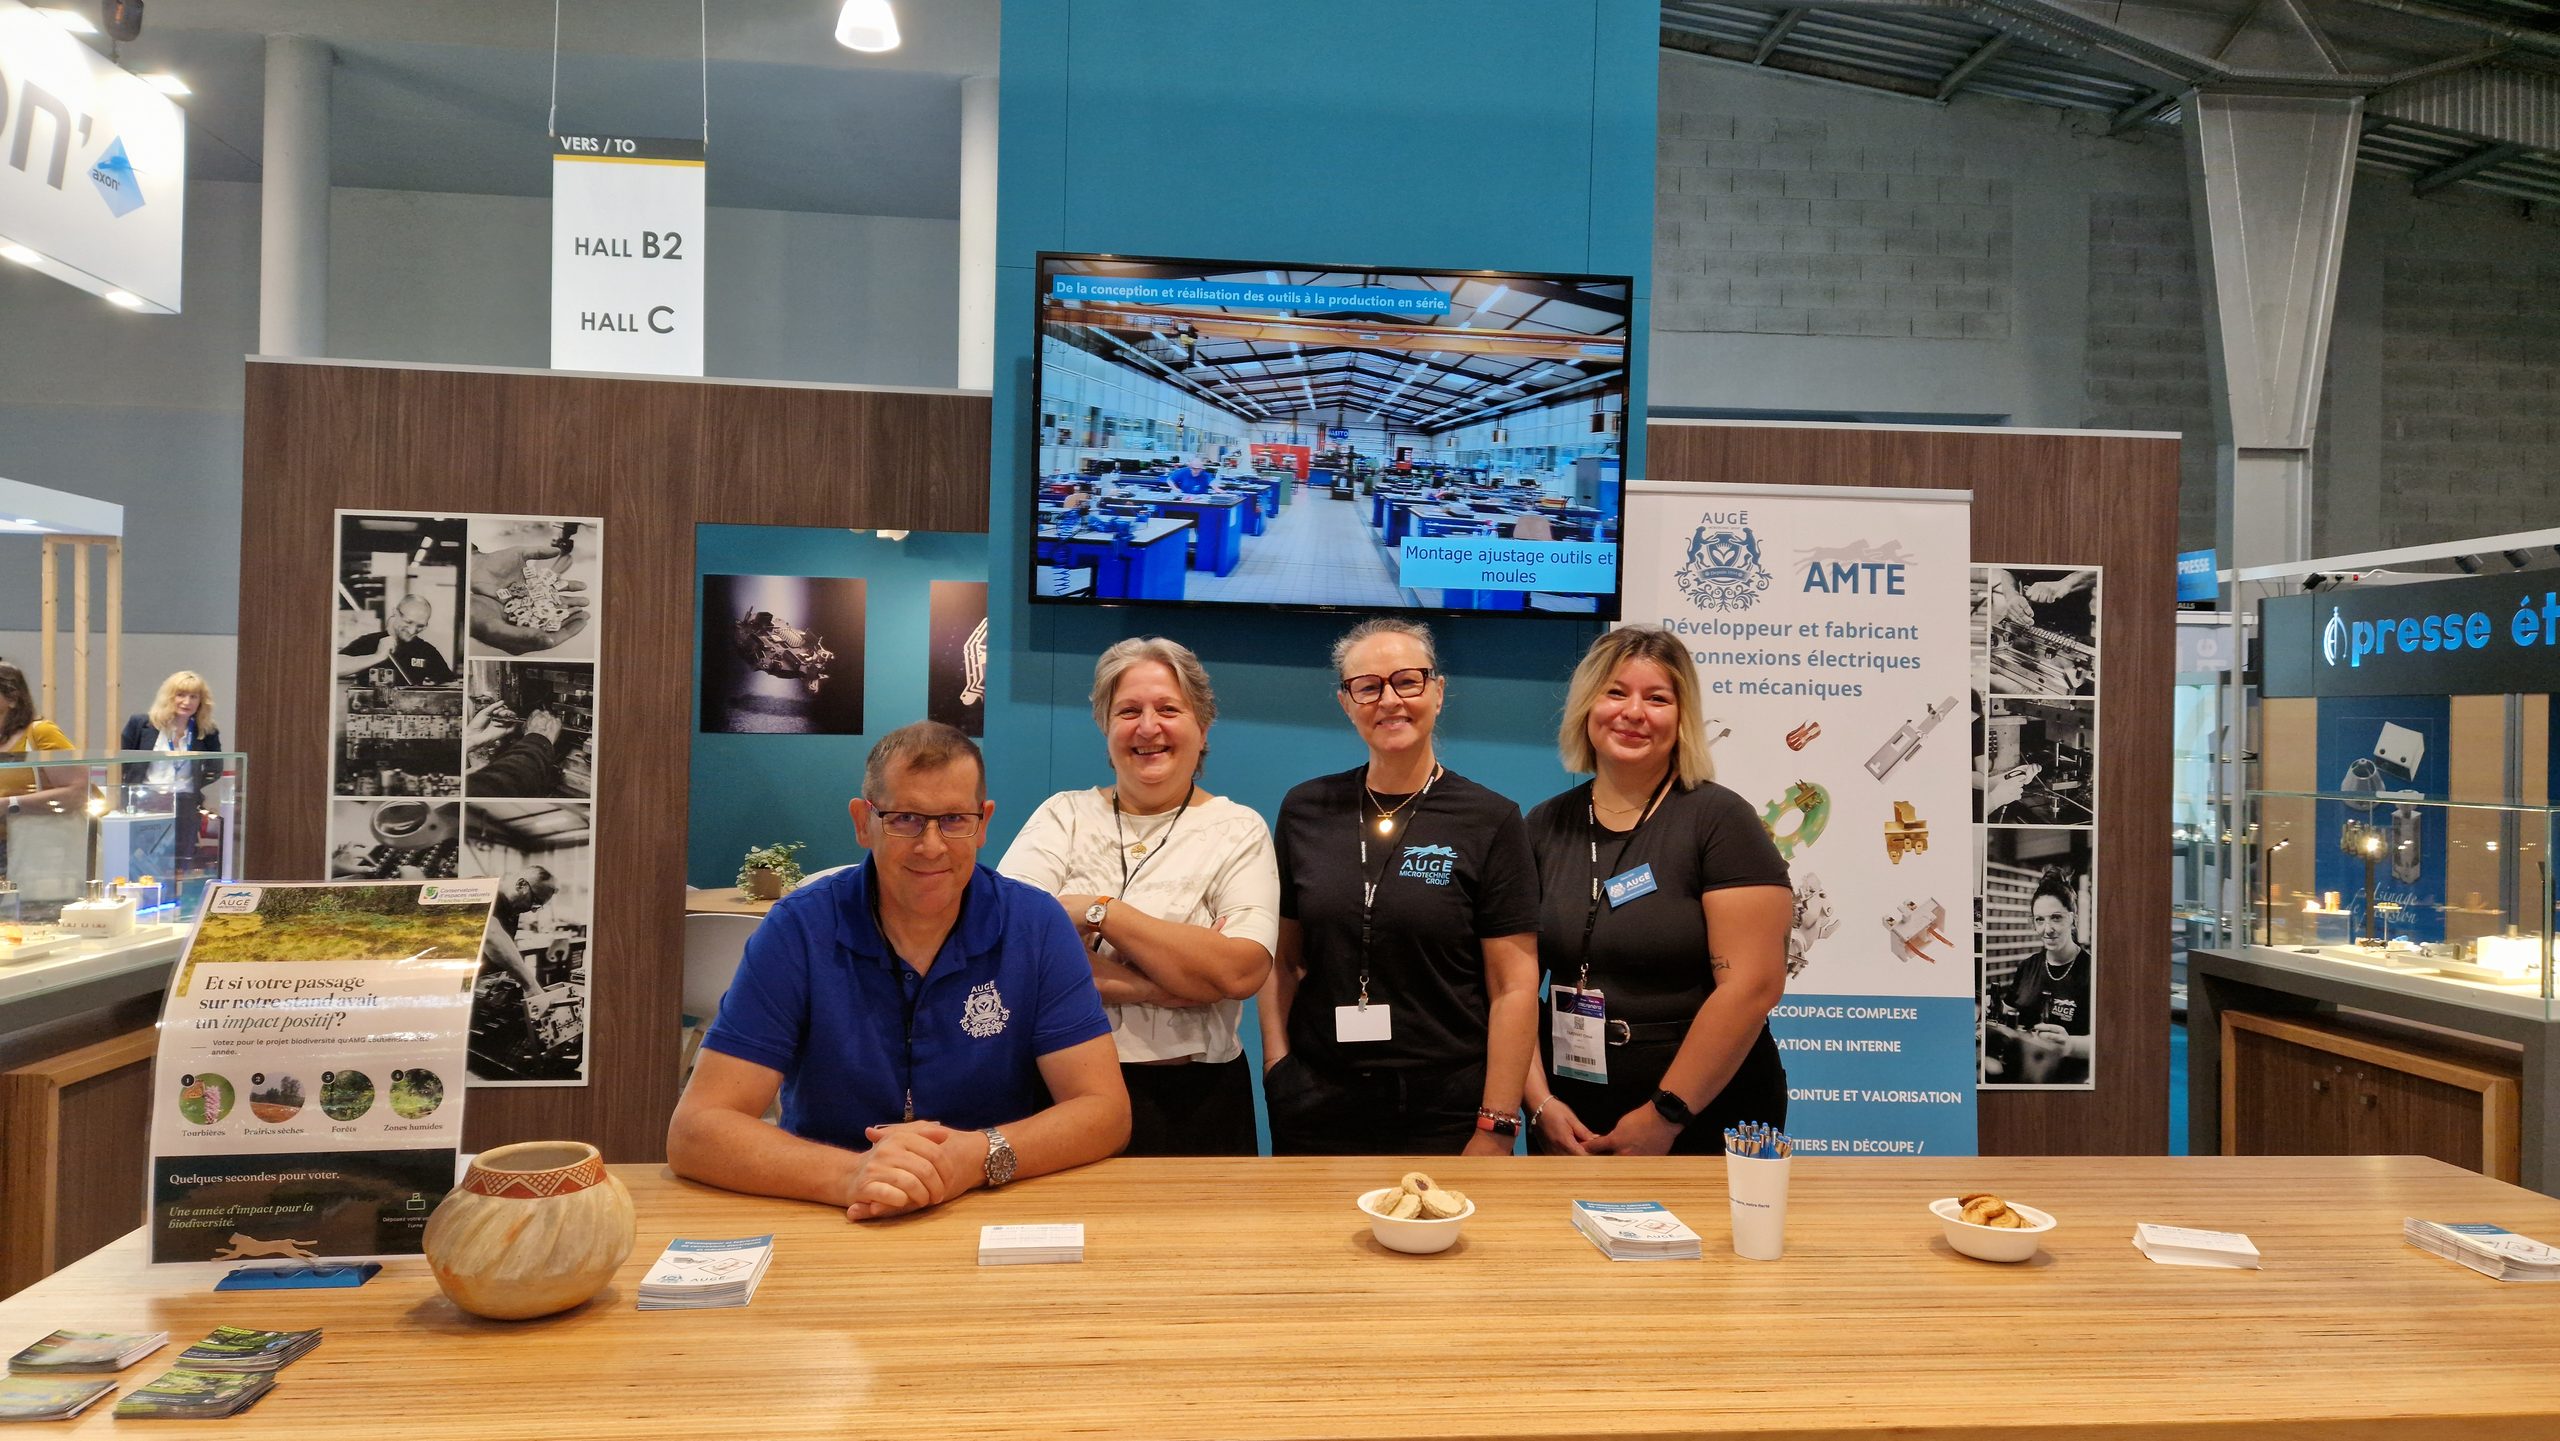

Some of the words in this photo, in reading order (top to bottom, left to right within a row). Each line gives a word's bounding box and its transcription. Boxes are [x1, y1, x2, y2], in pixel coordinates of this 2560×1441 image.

[560, 136, 599, 151] VERS
[603, 138, 611, 154] /
[614, 139, 636, 153] TO
[575, 237, 632, 258] HALL
[642, 231, 682, 260] B2
[1056, 281, 1073, 293] De
[1077, 282, 1087, 294] la
[1091, 285, 1158, 299] conception
[1162, 287, 1174, 298] et
[1177, 286, 1240, 301] réalisation
[1244, 290, 1264, 302] des
[1268, 291, 1301, 303] outils
[1304, 290, 1311, 303] à
[1315, 293, 1325, 304] la
[1329, 294, 1394, 308] production
[1398, 299, 1412, 308] en
[1416, 297, 1447, 309] série.
[581, 312, 638, 333] HALL
[648, 305, 675, 334] C
[1406, 545, 1472, 564] Montage
[1478, 547, 1545, 566] ajustage
[1550, 550, 1592, 565] outils
[1598, 552, 1613, 565] et
[2178, 558, 2210, 575] PRESSE
[1481, 569, 1536, 583] moules
[1803, 561, 1905, 595] AMTE
[1662, 617, 1793, 641] Développeur
[1798, 622, 1819, 638] et
[1825, 620, 1919, 640] fabricant
[2351, 611, 2492, 668] presse
[1690, 648, 1801, 666] onnexions
[1807, 649, 1921, 673] électriques
[1712, 679, 1733, 694] et
[1739, 677, 1863, 701] mécaniques
[1399, 870, 1451, 880] MICROTECHNIC
[1426, 878, 1450, 886] GROUP
[205, 976, 224, 990] Et
[228, 976, 244, 990] si
[246, 978, 293, 990] votre
[294, 977, 365, 992] passage
[199, 998, 230, 1009] sur
[232, 998, 281, 1009] notre
[284, 992, 334, 1008] stand
[337, 993, 378, 1008] avait
[1847, 1007, 1918, 1020] COMPLEXE
[195, 1017, 219, 1030] un
[222, 1014, 279, 1033] impact
[237, 1039, 254, 1047] pour
[266, 1037, 289, 1047] projet
[291, 1036, 336, 1045] biodiversité
[1825, 1039, 1843, 1051] EN
[1846, 1040, 1902, 1052] INTERNE
[1788, 1089, 1840, 1101] OINTUE
[1843, 1090, 1859, 1101] ET
[1862, 1090, 1962, 1103] VALORISATION
[182, 1128, 226, 1137] Tourbières
[277, 1126, 305, 1135] sèches
[331, 1125, 357, 1133] Forêts
[384, 1124, 407, 1132] Zones
[409, 1122, 443, 1131] humides
[1831, 1139, 1849, 1152] EN
[1853, 1138, 1914, 1152] DÉCOUPE
[1917, 1141, 1925, 1155] /
[169, 1173, 223, 1186] Quelques
[225, 1171, 277, 1183] secondes
[279, 1172, 306, 1184] pour
[308, 1171, 340, 1180] voter.
[169, 1206, 191, 1217] Une
[192, 1206, 225, 1216] année
[226, 1203, 273, 1217] d'impact
[274, 1205, 302, 1215] pour
[302, 1202, 313, 1213] la
[168, 1217, 235, 1229] biodiversité.
